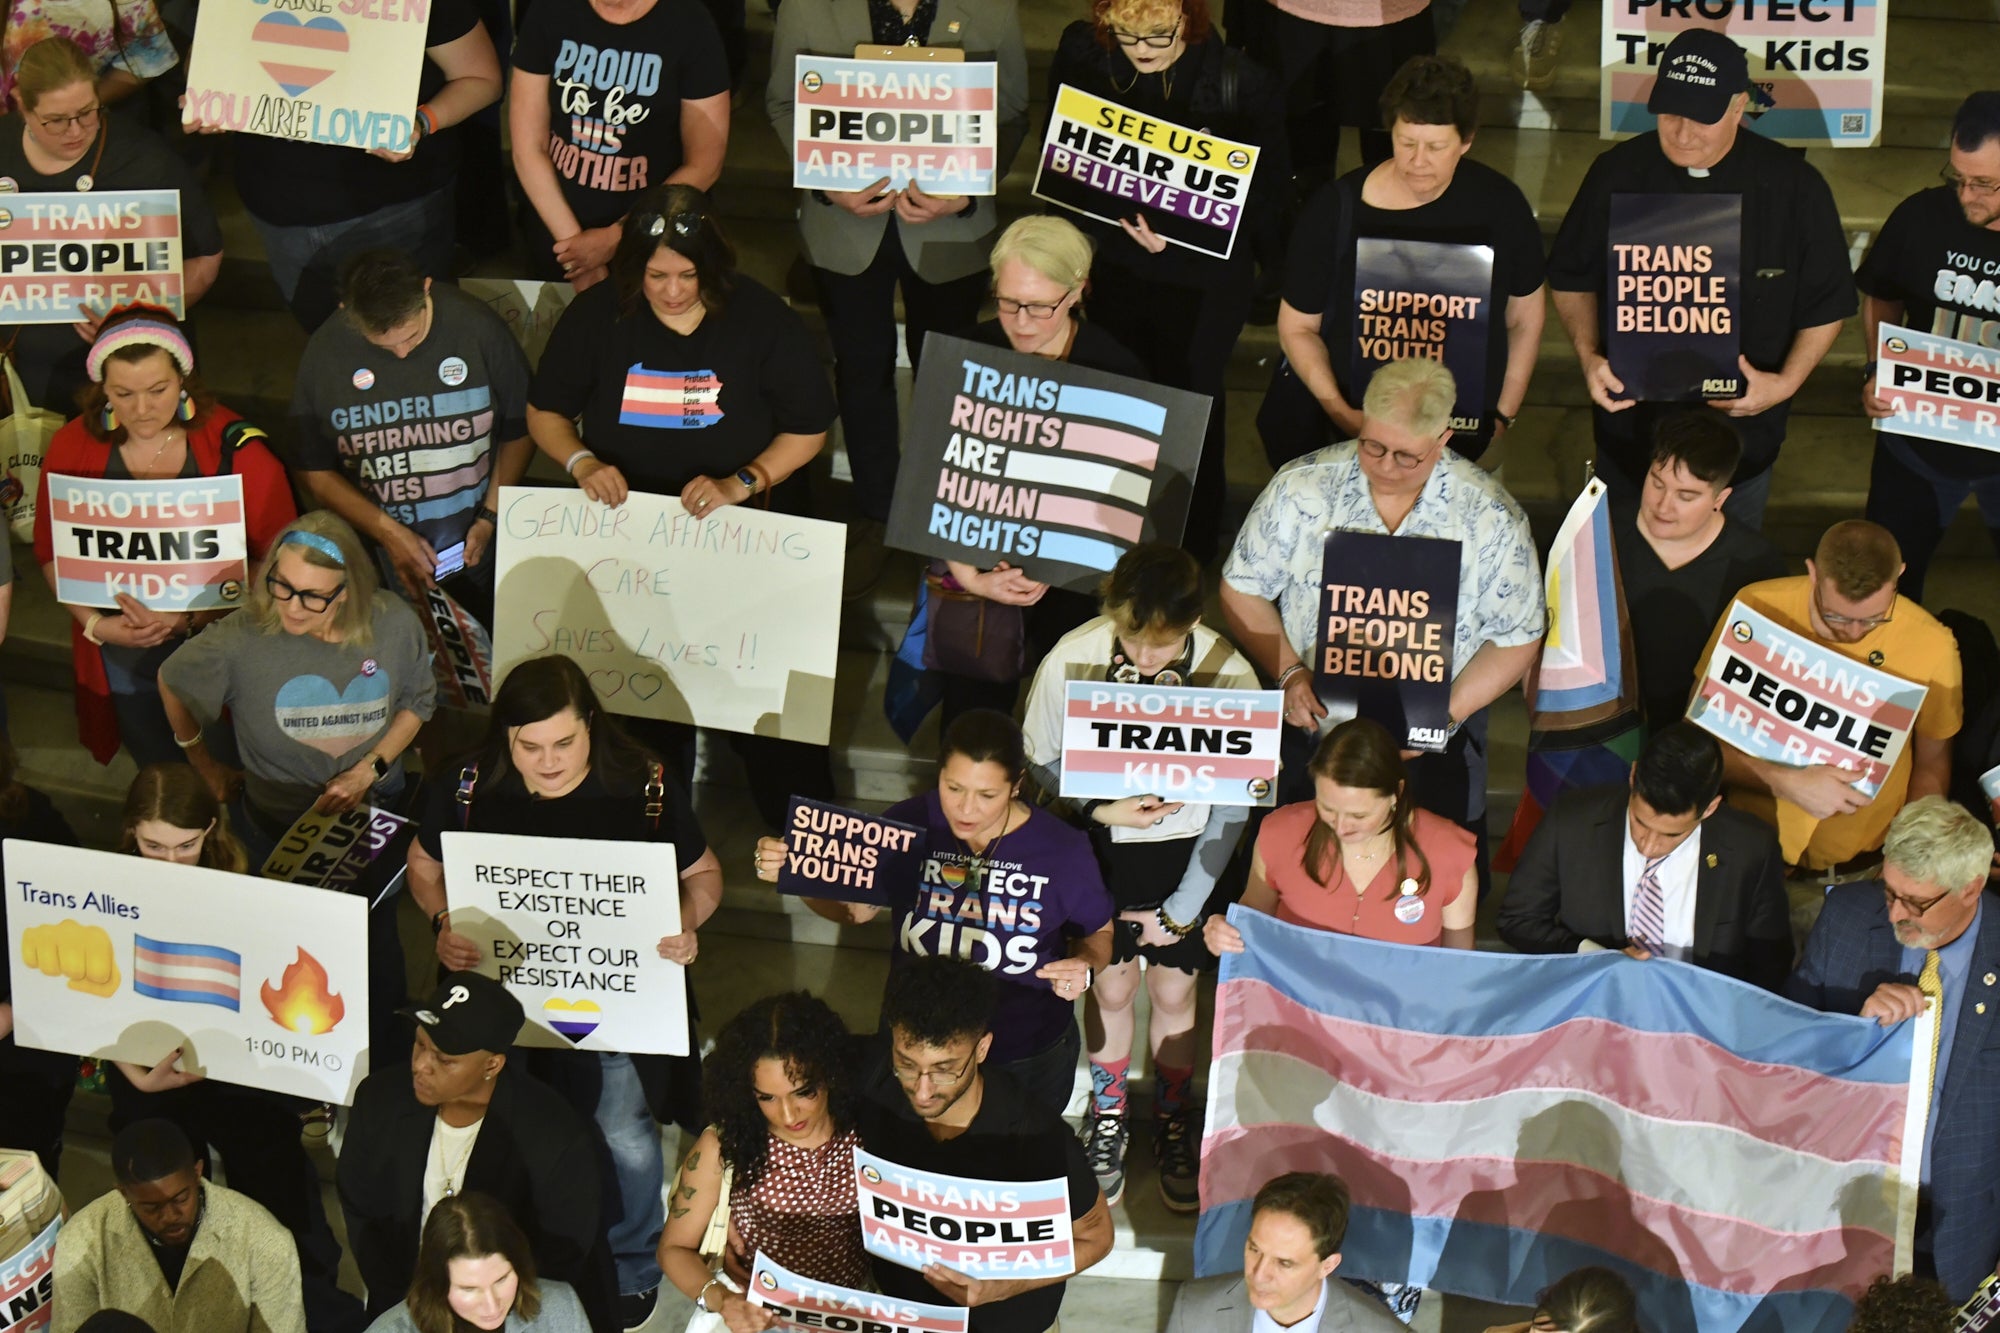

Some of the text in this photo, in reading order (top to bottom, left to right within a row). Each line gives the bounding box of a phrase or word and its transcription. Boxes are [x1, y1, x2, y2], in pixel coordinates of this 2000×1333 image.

[553, 39, 663, 97] PROUD
[1671, 54, 1718, 73] WE BELONG
[1686, 65, 1698, 73] TO
[1765, 40, 1869, 71] Kids
[835, 70, 953, 101] TRANS
[1666, 70, 1716, 86] EACH OTHER
[556, 77, 650, 126] to be
[186, 87, 411, 150] YOU ARE LOVED
[571, 115, 627, 155] HIS
[810, 109, 981, 144] PEOPLE
[1097, 107, 1213, 161] SEE US
[550, 131, 649, 191] MOTHER
[804, 149, 986, 183] ARE REAL
[1057, 120, 1240, 200] HEAR US
[1051, 148, 1232, 227] BELIEVE US
[26, 201, 142, 231] TRANS
[1, 241, 169, 273] PEOPLE
[1613, 244, 1713, 273] TRANS
[1946, 250, 1981, 271] YOU
[0, 282, 176, 311] ARE REAL
[1359, 288, 1481, 320] SUPPORT
[1617, 275, 1726, 304] PEOPLE
[1359, 314, 1446, 342] TRANS
[1616, 305, 1731, 334] BELONG
[1358, 337, 1444, 364] YOUTH
[684, 374, 711, 383] Protect
[684, 386, 711, 394] Believe
[962, 360, 1059, 411] TRANS
[1702, 378, 1737, 392] ACLU
[331, 396, 431, 430] GENDER
[683, 397, 701, 405] Love
[683, 408, 705, 416] Trans
[1891, 397, 1961, 431] ARE
[337, 418, 472, 456] AFFIRMING
[682, 417, 700, 426] Kids
[950, 394, 1063, 448] RIGHTS
[943, 433, 1006, 478] ARE
[67, 488, 220, 519] PROTECT
[937, 467, 1038, 520] HUMAN
[505, 493, 811, 560] GENDER AFFIRMING
[928, 502, 1040, 557] RIGHTS
[72, 527, 220, 561] TRANS
[105, 571, 190, 601] KIDS
[585, 558, 671, 596] CARE
[1326, 584, 1430, 619] TRANS
[526, 610, 615, 652] SAVES
[634, 628, 720, 667] LIVES
[1327, 616, 1442, 651] PEOPLE
[1324, 647, 1445, 683] BELONG
[1763, 633, 1881, 708] TRANS
[284, 717, 319, 728] UNITED
[322, 713, 361, 726] AGAINST
[1090, 690, 1260, 721] PROTECT
[1703, 690, 1776, 749] ARE
[1720, 655, 1893, 759] PEOPLE
[1091, 722, 1253, 755] TRANS
[1408, 727, 1445, 743] ACLU
[1123, 761, 1217, 793] KIDS
[282, 822, 321, 855] US
[320, 810, 370, 849] US
[361, 818, 398, 851] US
[793, 806, 917, 853] SUPPORT
[790, 829, 879, 869] TRANS
[933, 851, 956, 863] LITITZ
[1000, 862, 1023, 872] LOVE
[475, 864, 647, 895] RESPECT THEIR
[788, 854, 875, 889] YOUTH
[17, 881, 140, 920] Trans Allies
[498, 891, 627, 918] EXISTENCE
[914, 881, 1044, 933] TRANS
[547, 920, 582, 940] OR
[900, 911, 1039, 974] KIDS
[493, 939, 640, 968] EXPECT OUR
[499, 964, 637, 993] RESISTANCE
[442, 985, 470, 1009] P
[245, 1036, 320, 1067] 1:00 PM
[892, 1173, 1021, 1213] TRANS
[872, 1195, 1055, 1243] PEOPLE
[872, 1227, 1065, 1272] ARE REAL
[762, 1301, 938, 1333] PEOP
[792, 1282, 920, 1323] TRANS
